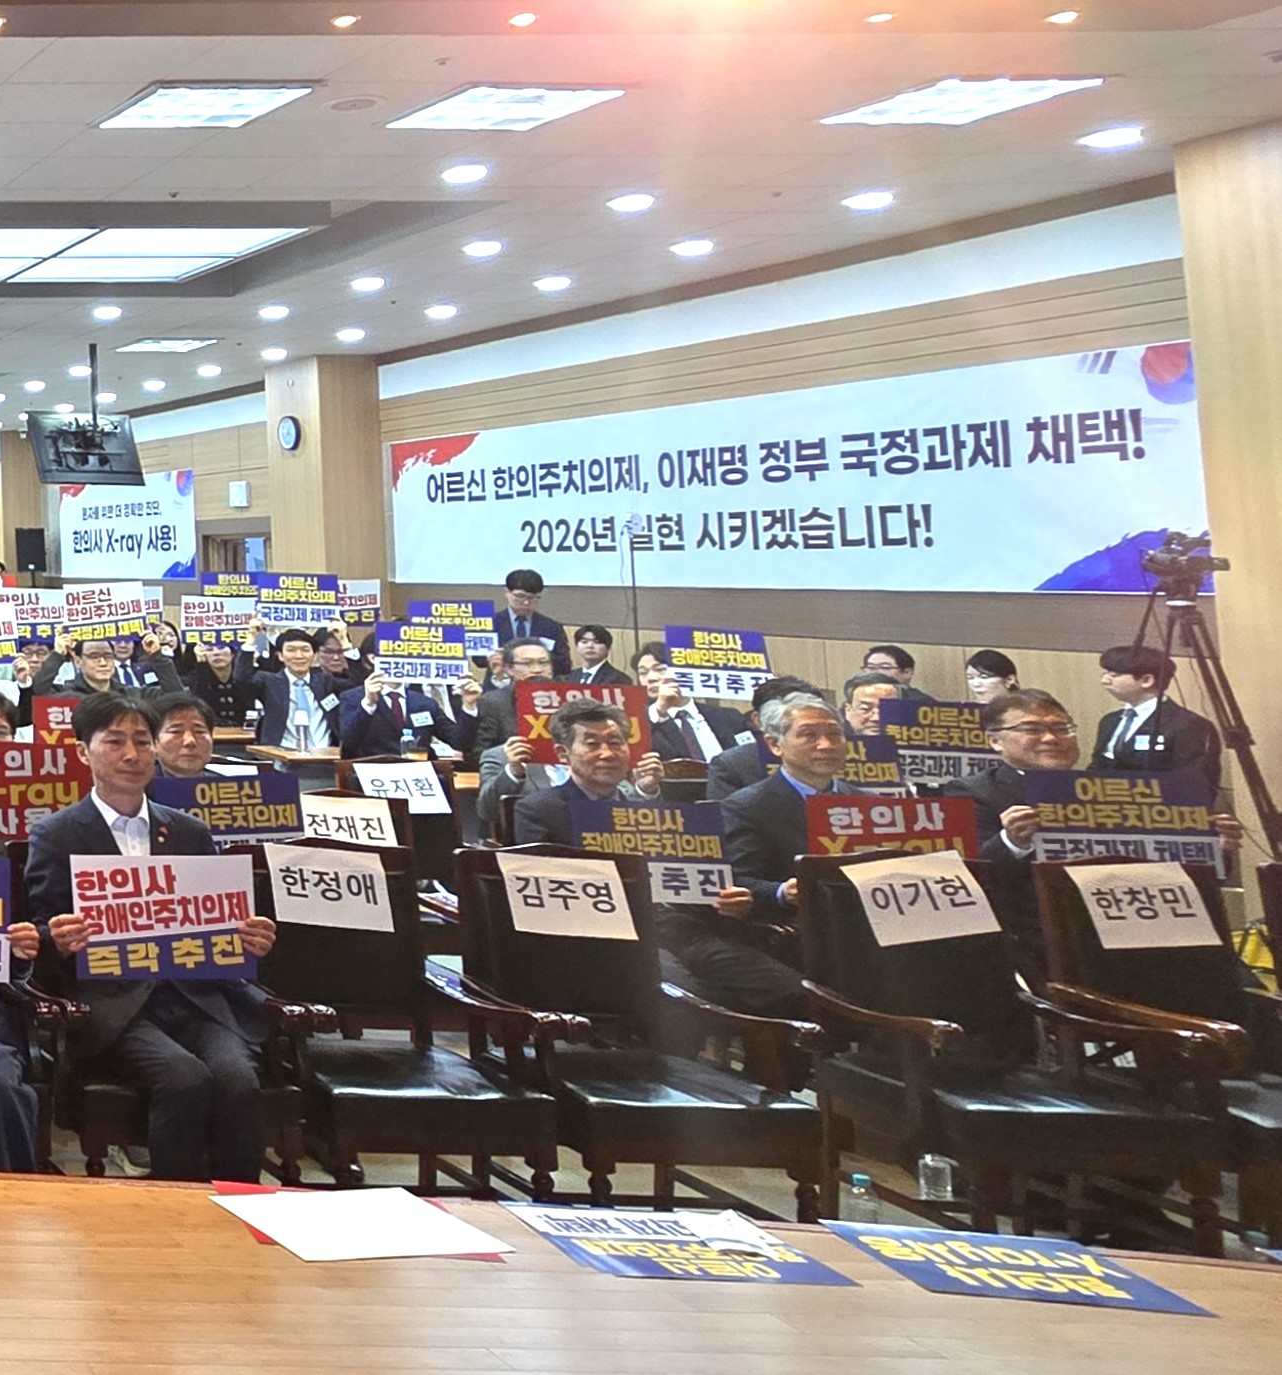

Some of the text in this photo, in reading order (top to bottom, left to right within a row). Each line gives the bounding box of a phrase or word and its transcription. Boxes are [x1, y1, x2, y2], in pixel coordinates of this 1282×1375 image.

[427, 408, 1146, 503] 어르신 한의주치의제, 이재명 정부 국정과제 채택!
[521, 516, 616, 552] 2026년
[697, 503, 933, 551] 시키겠습니다!
[73, 525, 177, 559] 한의사 X-ray 사용!
[279, 576, 318, 589] 어르신
[65, 587, 112, 606] 어르신
[184, 601, 224, 614] 한의사
[261, 589, 335, 603] 한의주치의제
[67, 599, 142, 622] 한의주치의제
[261, 606, 307, 621] 국정과제
[431, 602, 472, 617] 어르신
[400, 626, 443, 642] 어르신
[693, 631, 742, 650] 한의사
[379, 639, 464, 658] 한의주치의제
[670, 647, 768, 670] 장애인주치의제
[379, 660, 431, 679] 국정과제
[918, 706, 981, 729] 어르신
[196, 780, 263, 806] 어르신
[370, 777, 436, 799] 유지환
[1075, 777, 1162, 803] 어르신
[306, 812, 387, 841] 전재진
[612, 807, 685, 833] 한의사
[827, 802, 945, 836] 한의사
[1036, 803, 1211, 830] 한의주치의제
[74, 864, 176, 902] 한의사
[278, 866, 379, 906] 한정애
[516, 876, 617, 914] 김주영
[871, 874, 977, 915] 이기헌
[79, 890, 250, 935] 장애인주치의제
[1091, 885, 1198, 921] 한창민
[935, 1262, 1134, 1300] 한의사
